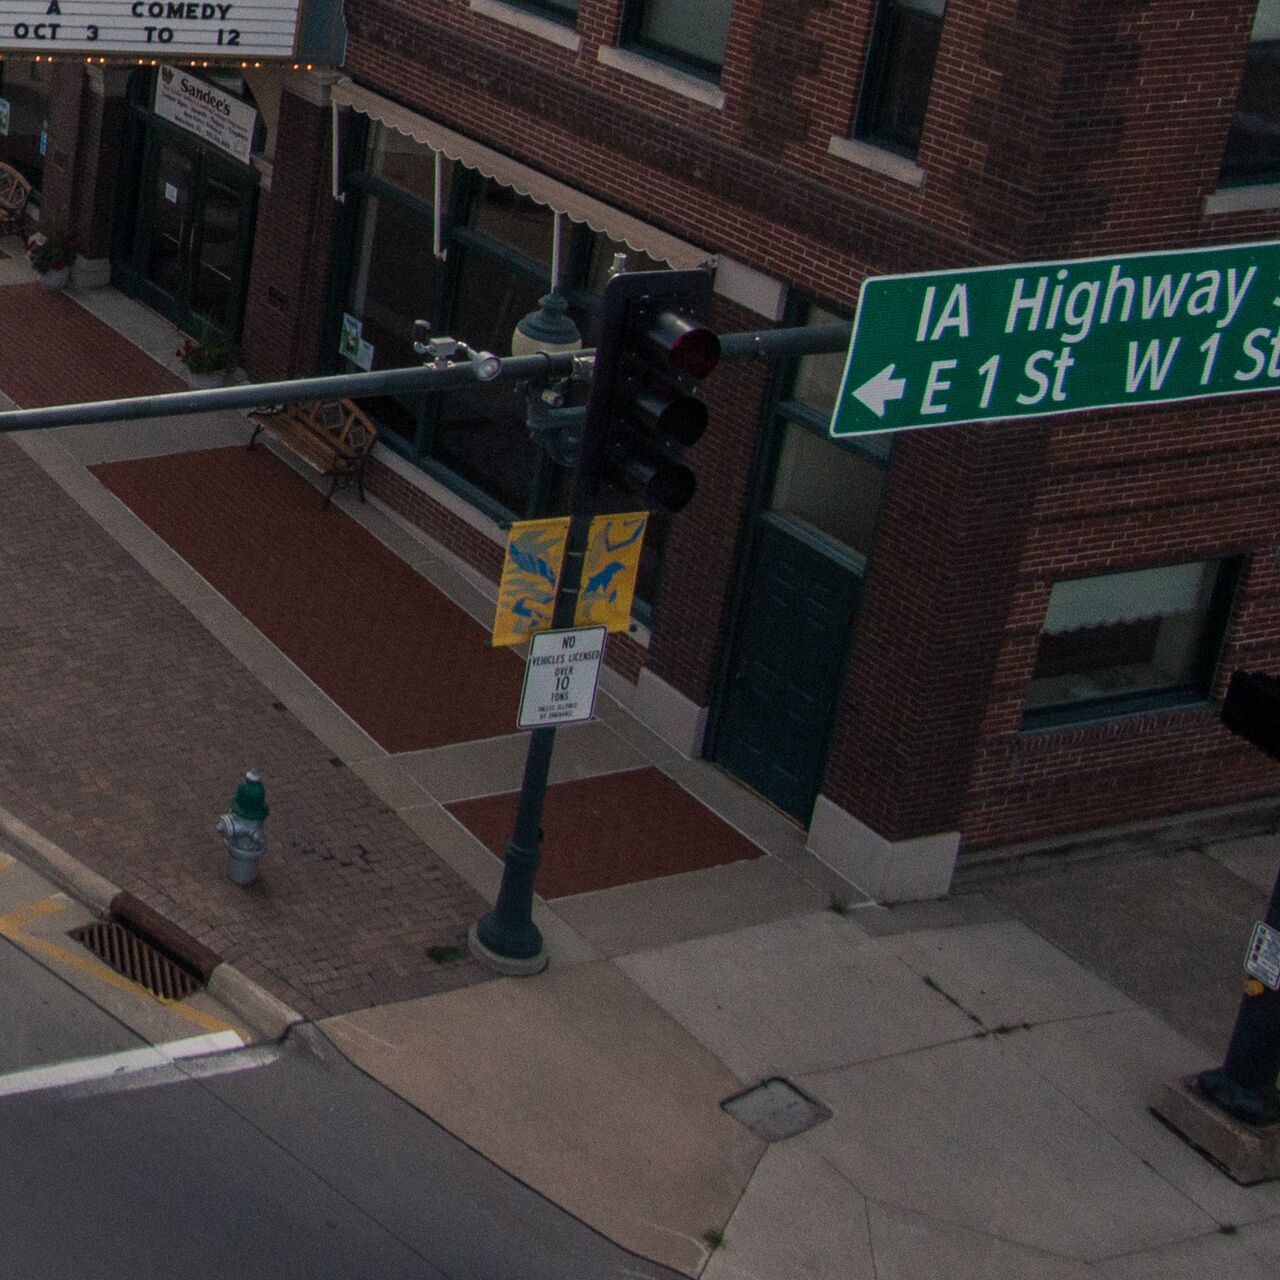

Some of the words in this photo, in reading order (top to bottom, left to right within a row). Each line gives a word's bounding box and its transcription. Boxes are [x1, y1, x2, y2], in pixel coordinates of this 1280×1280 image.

[45, 0, 62, 16] A
[131, 0, 233, 22] COMEDY
[13, 21, 60, 41] OCT
[85, 23, 100, 42] 3
[143, 25, 175, 44] TO
[216, 27, 241, 47] 12
[180, 77, 231, 117] Sandee's
[915, 283, 970, 343] IA
[1004, 264, 1259, 345] Highway
[919, 358, 958, 416] E
[977, 353, 1001, 410] 1
[1015, 346, 1076, 407] St
[1125, 336, 1182, 394] W
[1198, 331, 1222, 386] 1
[1233, 325, 1280, 382] St
[561, 635, 576, 650] NO
[531, 653, 566, 667] VEHICLES
[567, 649, 601, 665] LICENSED
[554, 665, 574, 677] OVER
[555, 675, 570, 691] 10
[550, 690, 569, 702] TONS
